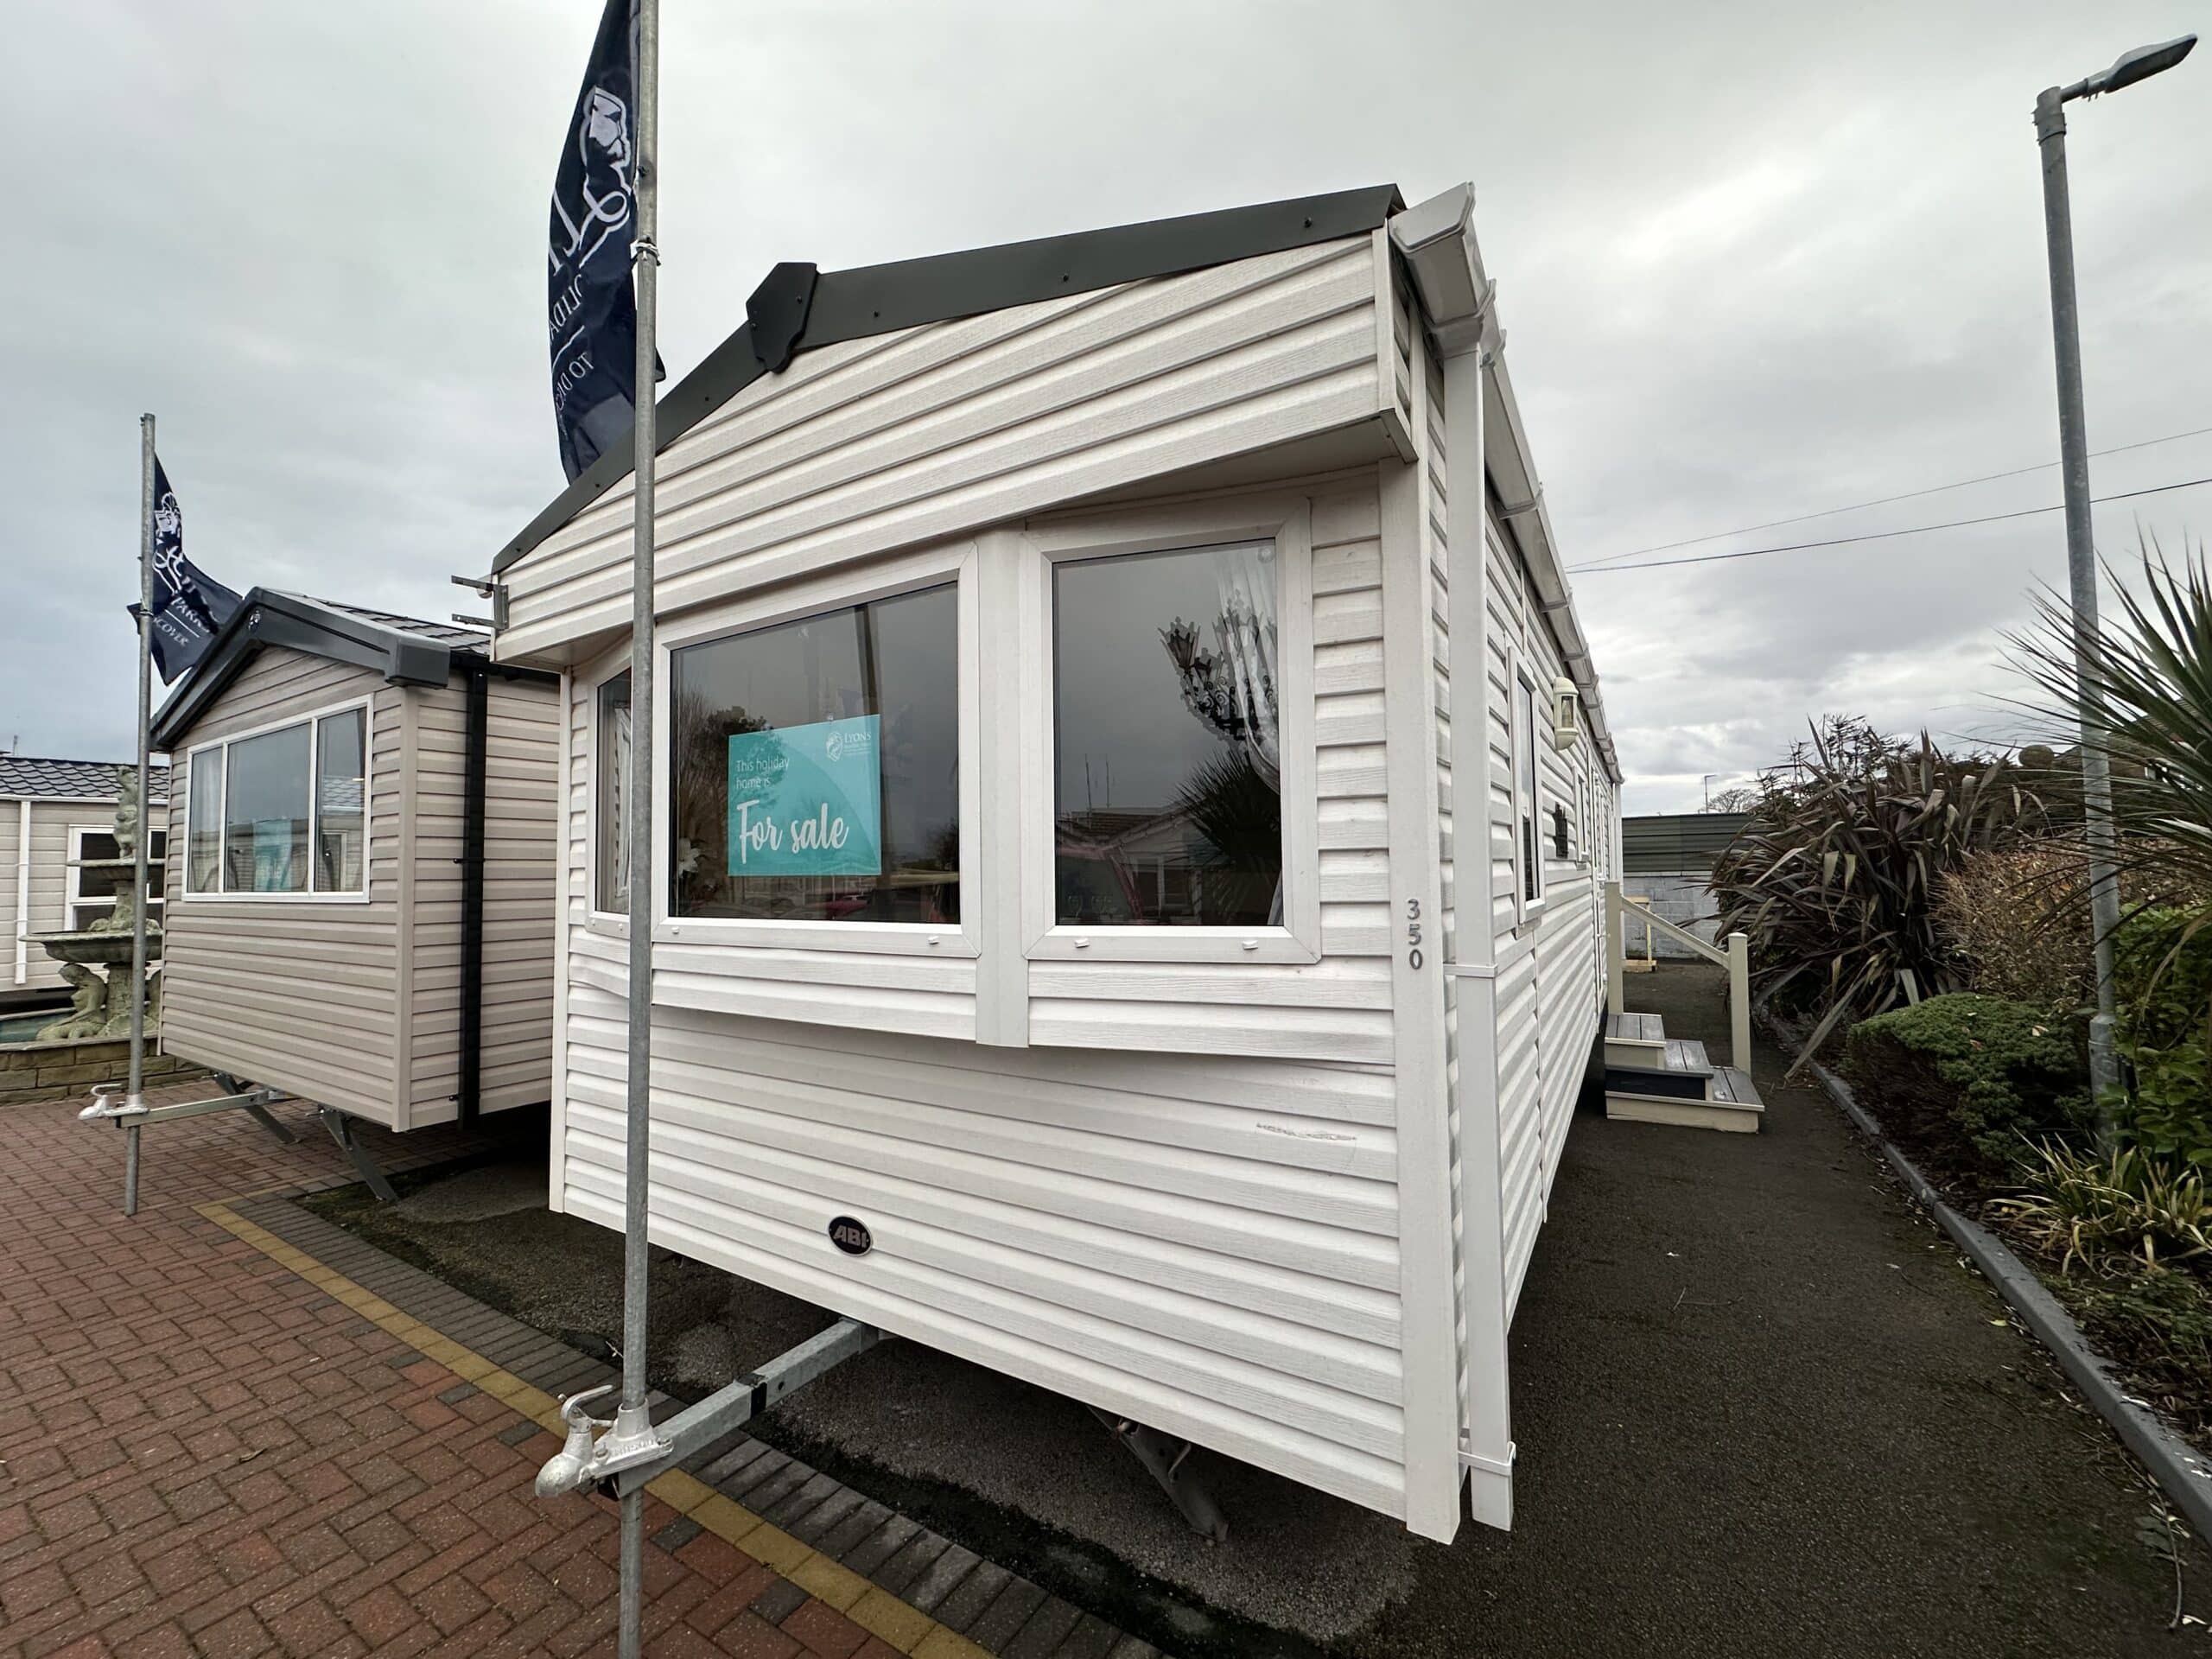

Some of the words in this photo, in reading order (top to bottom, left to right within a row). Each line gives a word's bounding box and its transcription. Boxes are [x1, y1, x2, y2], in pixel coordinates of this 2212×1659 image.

[736, 760, 754, 772] This
[756, 755, 790, 772] holiday
[736, 777, 761, 790] home
[764, 776, 771, 787] is
[736, 799, 783, 864] For
[791, 802, 849, 854] sale
[1407, 899, 1423, 969] 350
[833, 1224, 867, 1249] ABI
